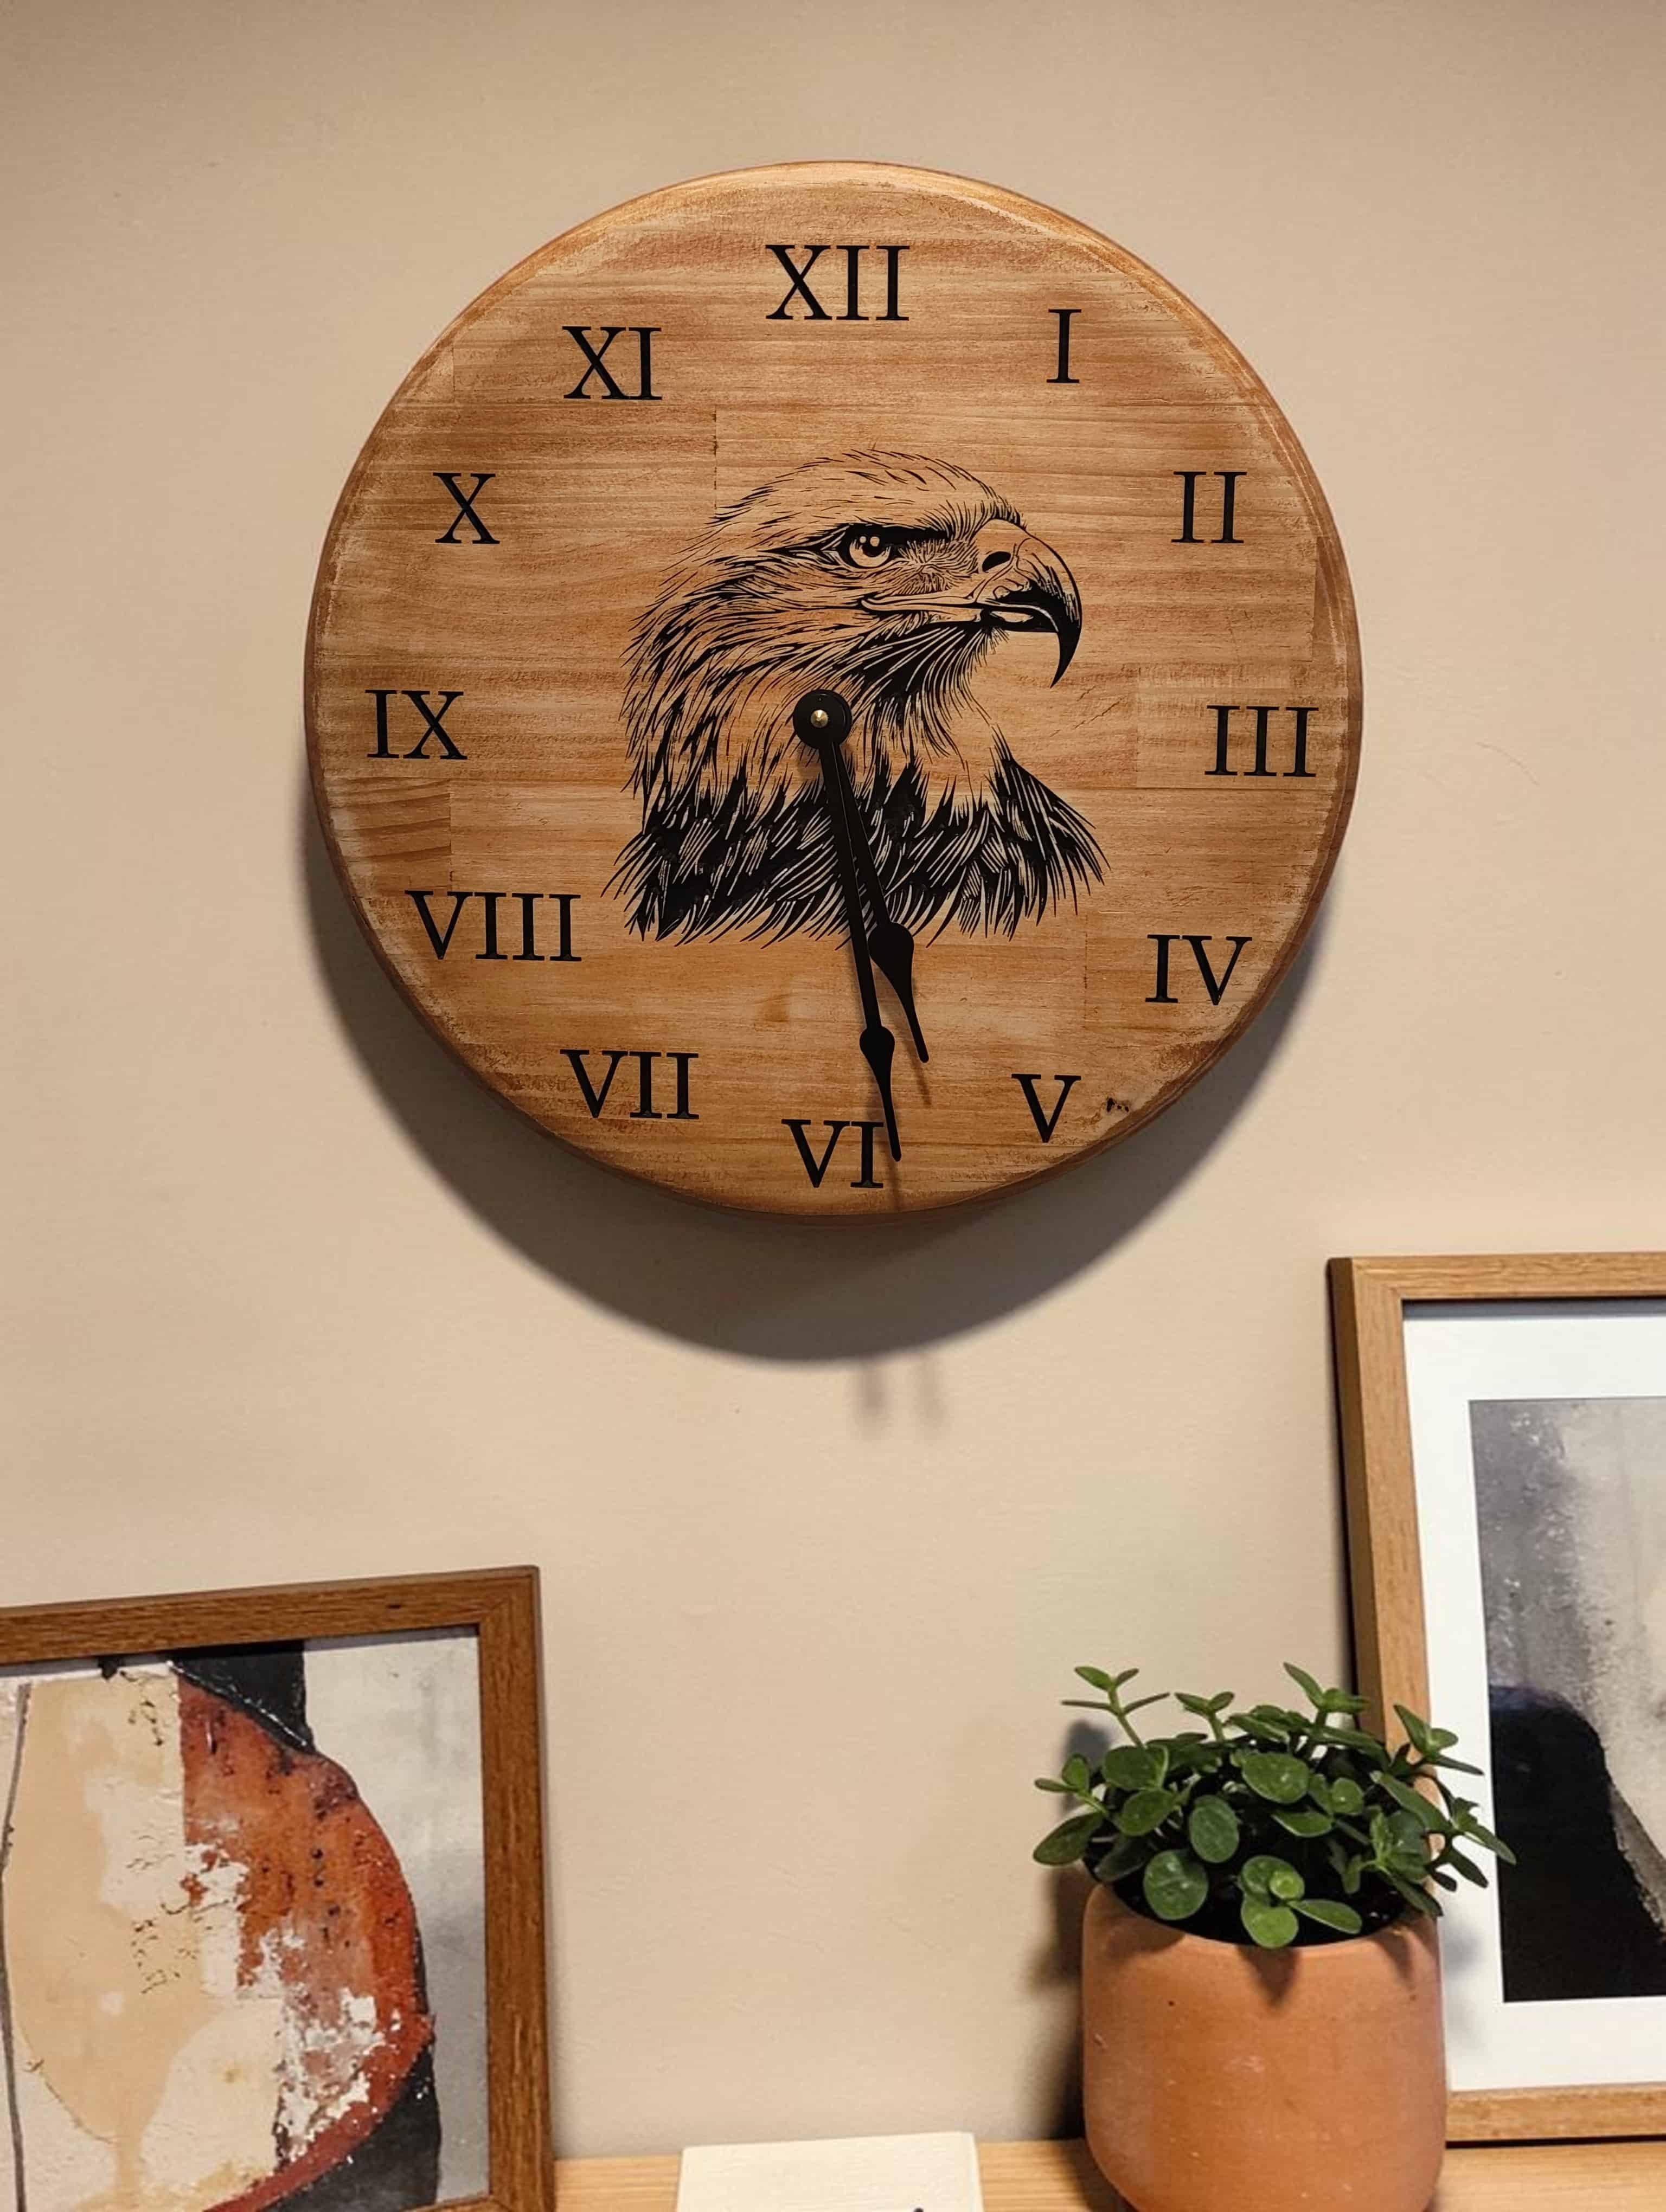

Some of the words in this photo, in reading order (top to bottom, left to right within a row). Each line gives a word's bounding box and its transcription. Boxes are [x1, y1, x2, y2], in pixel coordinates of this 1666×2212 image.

[765, 245, 910, 320] XII
[562, 326, 662, 400] XI
[1047, 309, 1081, 383] I
[433, 472, 500, 544] X
[1171, 471, 1247, 543] II
[364, 690, 467, 760] IX
[1204, 705, 1319, 777] III
[403, 890, 581, 961] VIII
[1145, 935, 1252, 1005] IV
[560, 1049, 699, 1120] VII
[1011, 1074, 1081, 1143] V
[781, 1118, 884, 1188] VI
